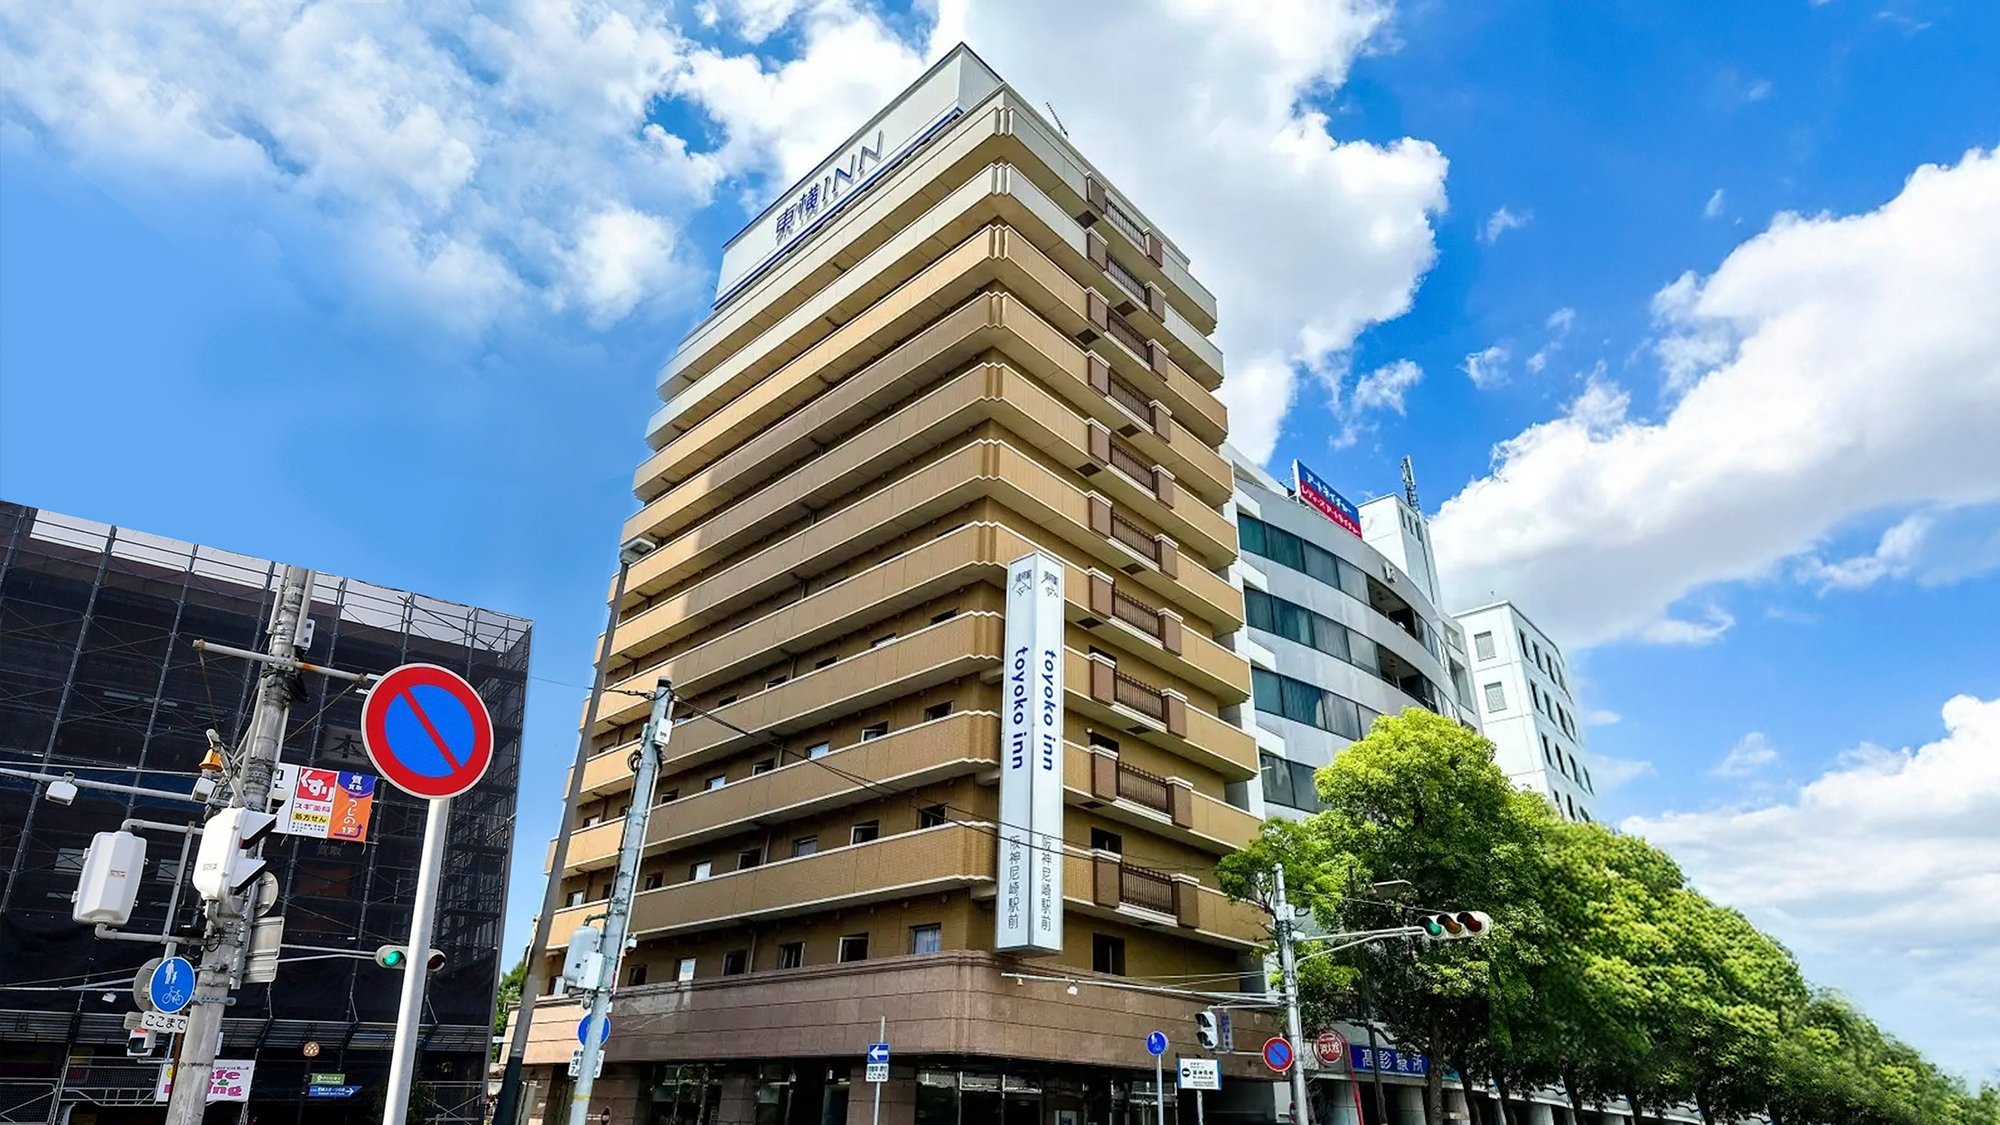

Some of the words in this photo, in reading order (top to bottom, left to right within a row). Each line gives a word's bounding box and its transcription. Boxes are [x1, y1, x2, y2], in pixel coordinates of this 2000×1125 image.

[1012, 646, 1028, 725] toyoko
[1042, 650, 1057, 727] toyoko
[1012, 732, 1028, 770] inn
[1042, 734, 1056, 772] inn
[300, 769, 334, 801] くすり
[145, 1014, 186, 1031] ここまで
